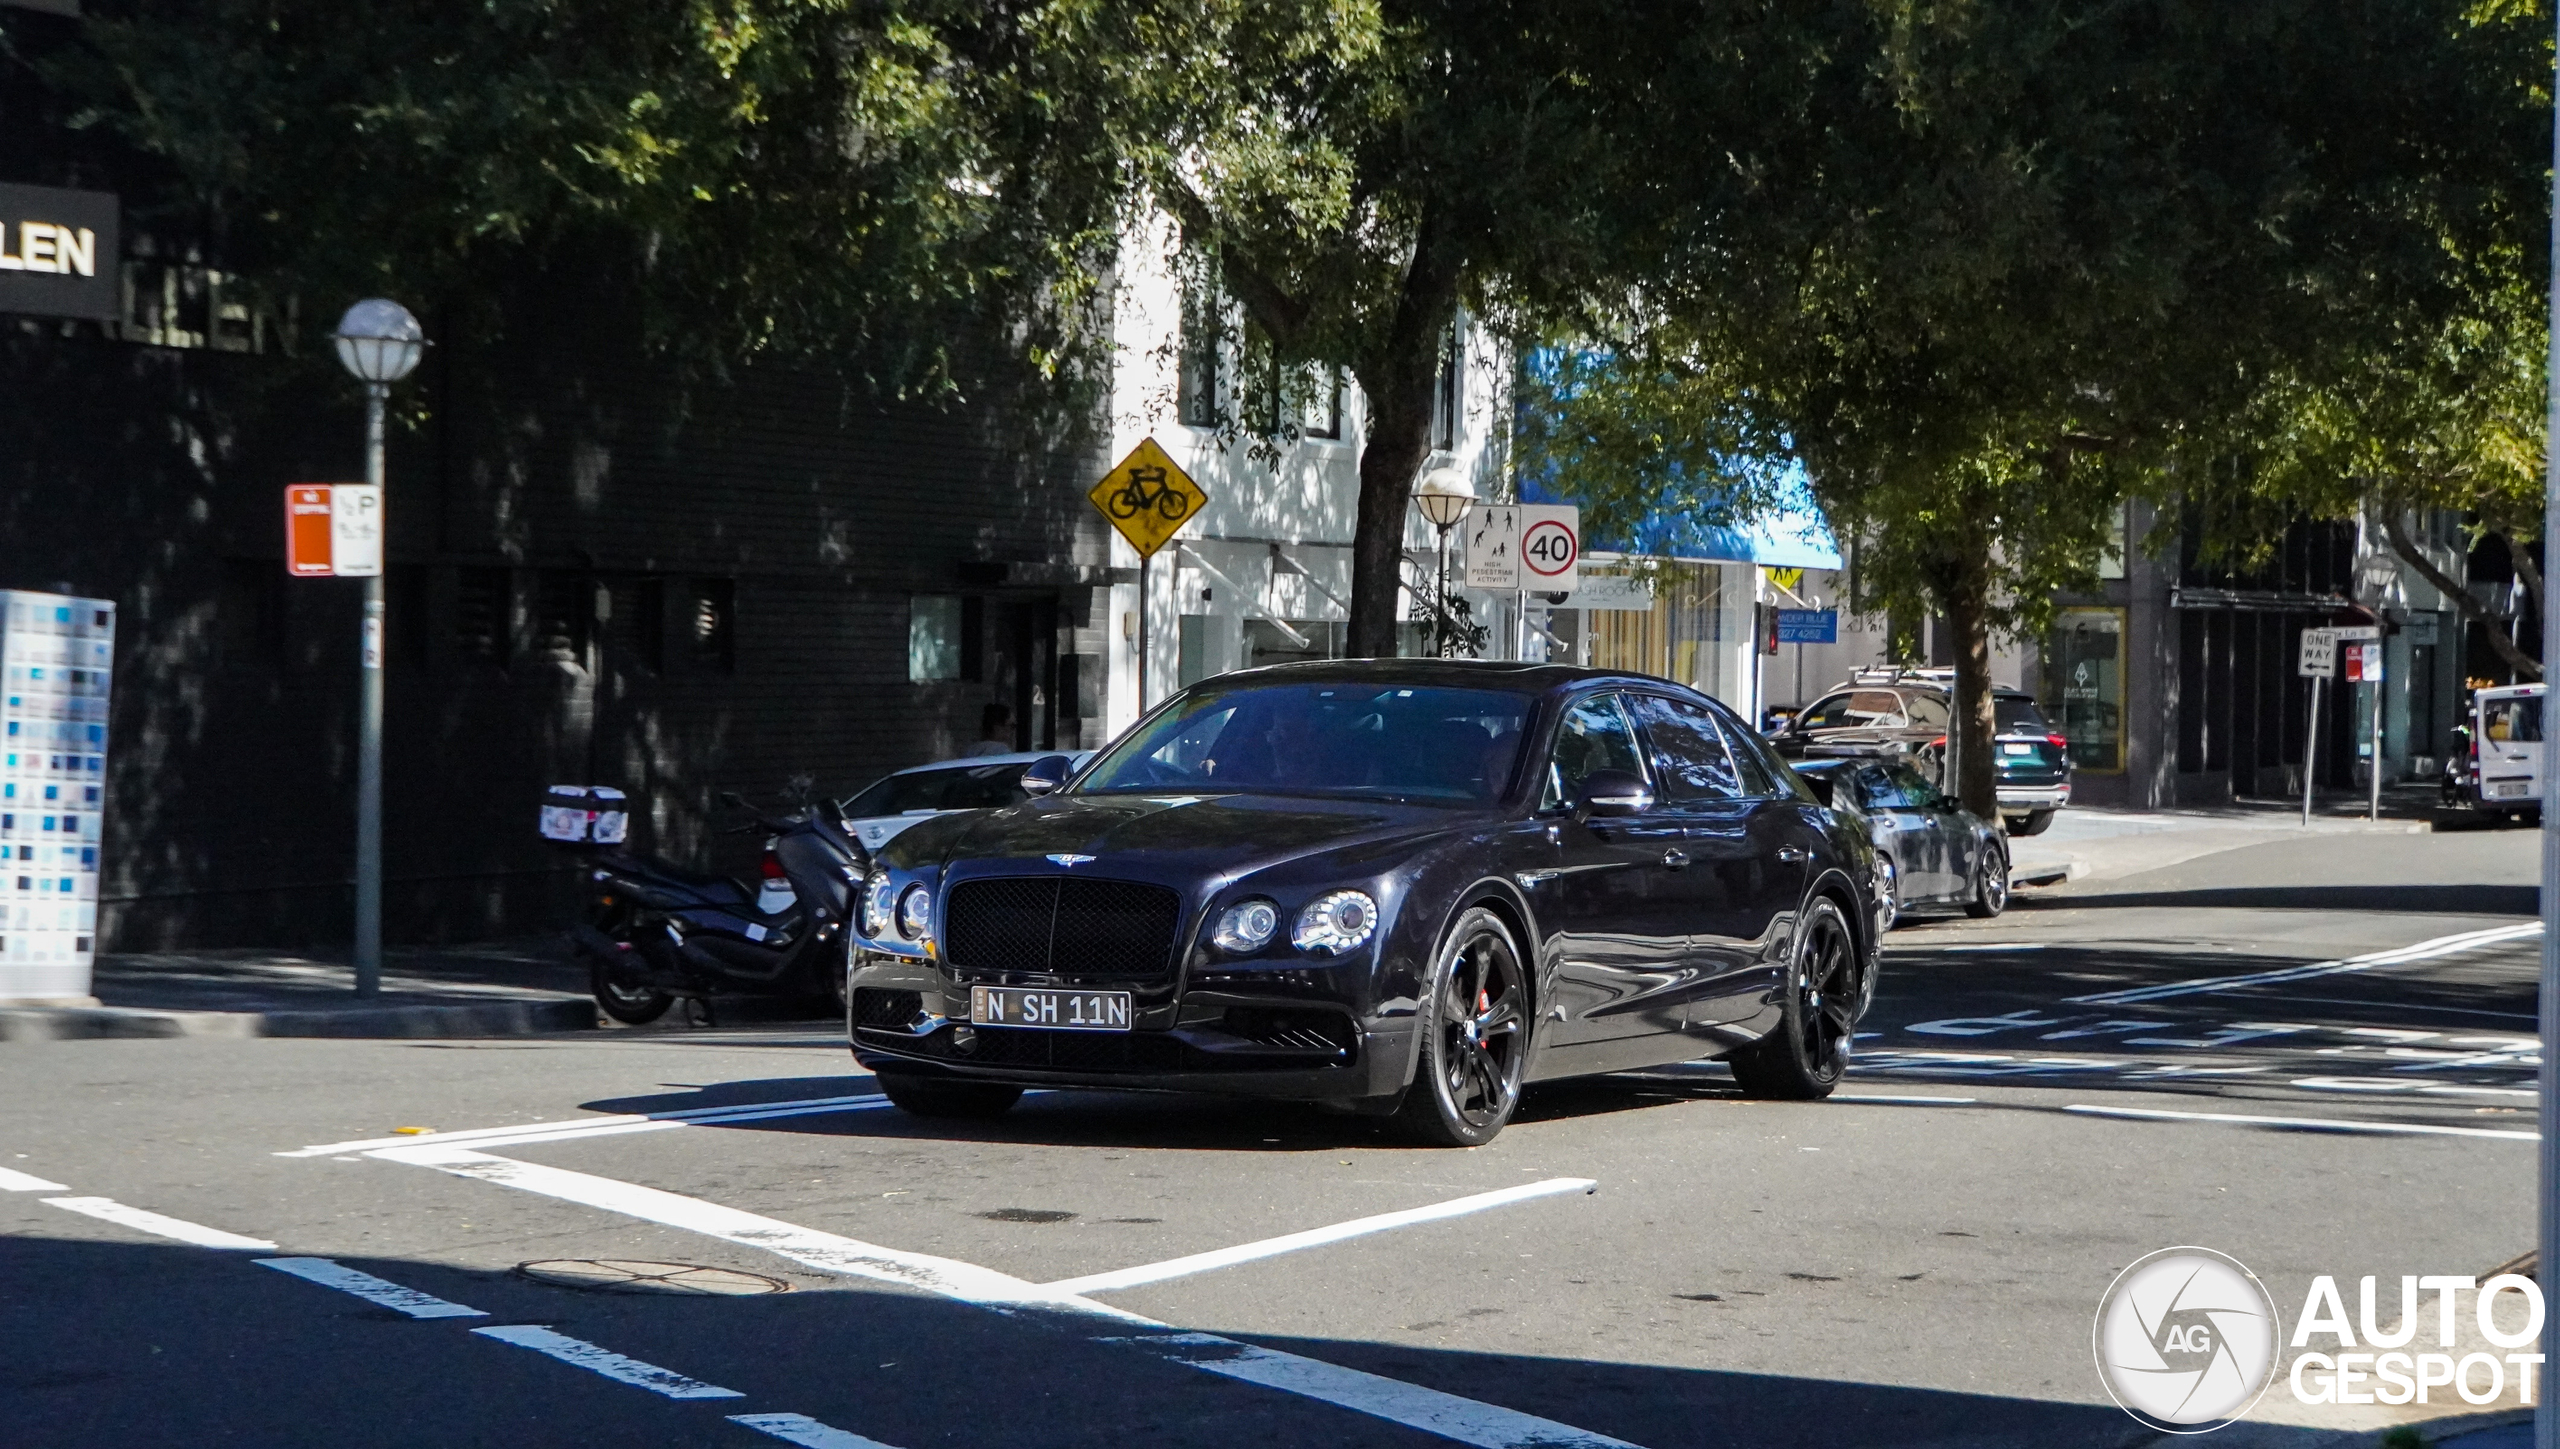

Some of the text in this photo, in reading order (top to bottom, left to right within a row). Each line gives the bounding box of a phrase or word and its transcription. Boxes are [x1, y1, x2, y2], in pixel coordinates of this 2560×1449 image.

[1529, 535, 1569, 561] 40
[1779, 629, 1795, 640] 327
[2306, 635, 2331, 647] ONE
[2304, 649, 2331, 660] WAY
[988, 993, 1126, 1025] N SH 11N
